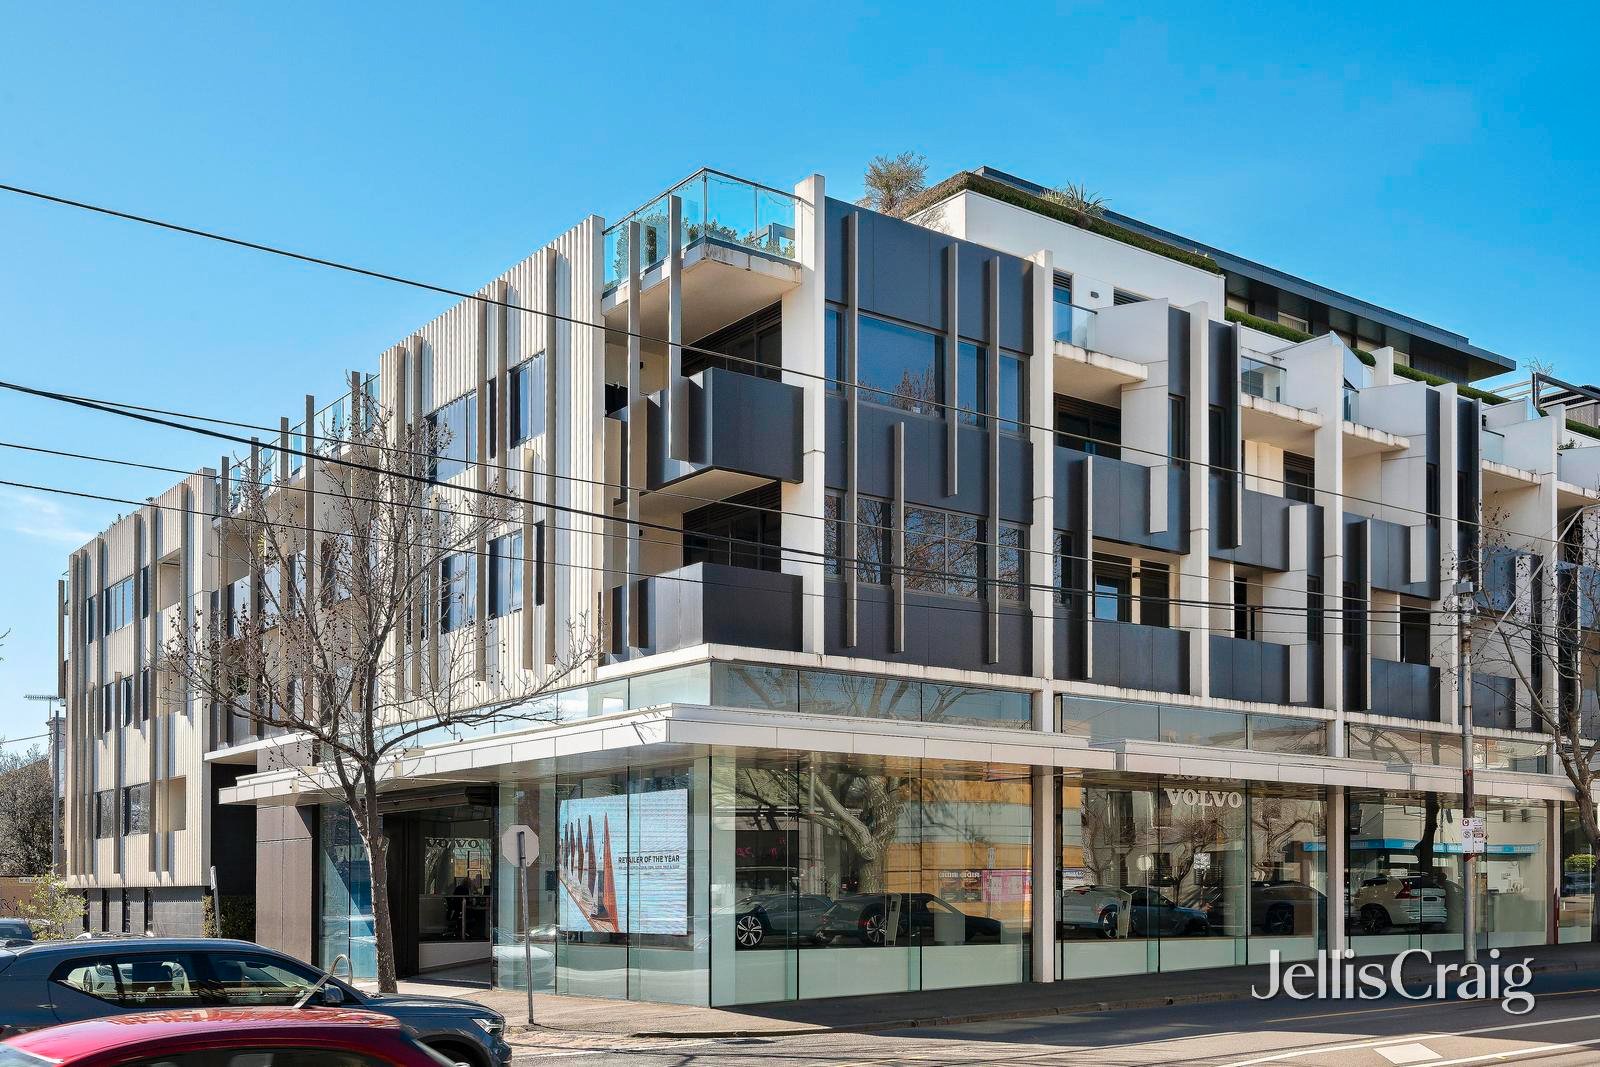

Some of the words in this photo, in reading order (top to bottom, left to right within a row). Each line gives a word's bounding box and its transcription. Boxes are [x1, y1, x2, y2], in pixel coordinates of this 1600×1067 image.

[1163, 787, 1243, 809] VOLVO
[424, 838, 480, 849] VOVO
[618, 856, 643, 864] RETAILER
[643, 855, 652, 863] OF
[652, 855, 664, 863] THE
[664, 854, 680, 862] YEAR
